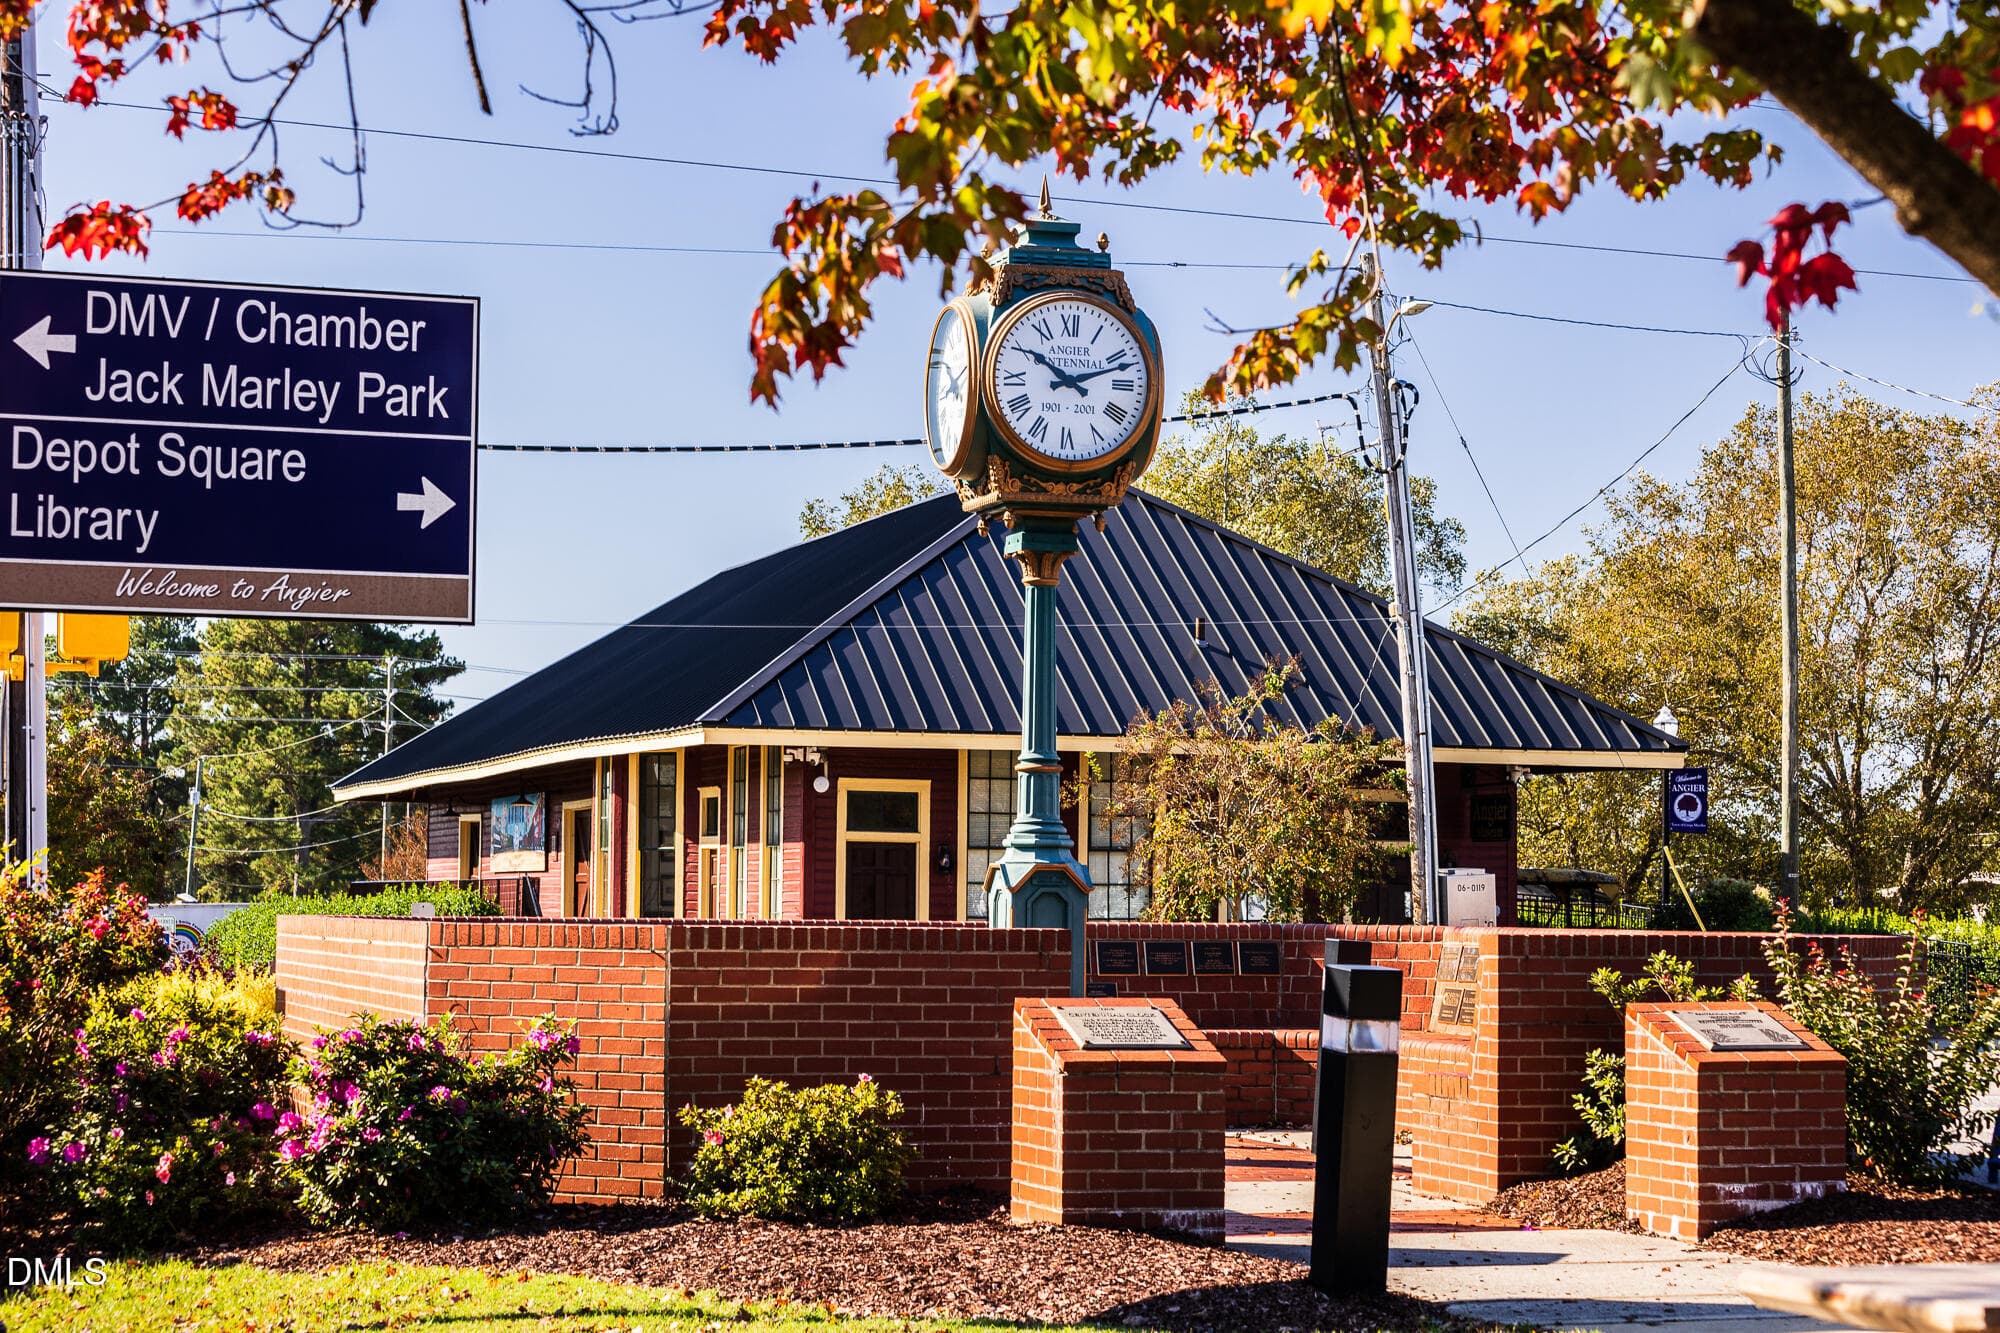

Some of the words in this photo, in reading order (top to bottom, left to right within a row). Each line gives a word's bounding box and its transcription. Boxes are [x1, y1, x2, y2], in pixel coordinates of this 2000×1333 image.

[86, 290, 190, 338] DMV
[205, 297, 220, 341] /
[235, 300, 426, 352] Chamber
[1048, 345, 1090, 356] ANGIER
[85, 358, 184, 405] Jack
[202, 363, 341, 424] Marley
[358, 372, 449, 419] Park
[1041, 402, 1061, 412] 1901
[1073, 404, 1095, 414] 2001
[12, 426, 140, 483] Depot
[157, 432, 306, 489] Square
[10, 492, 159, 553] Library
[115, 568, 221, 598] Welcome
[231, 577, 254, 599] to
[261, 574, 351, 610] Angier
[1671, 784, 1705, 793] ANGIER
